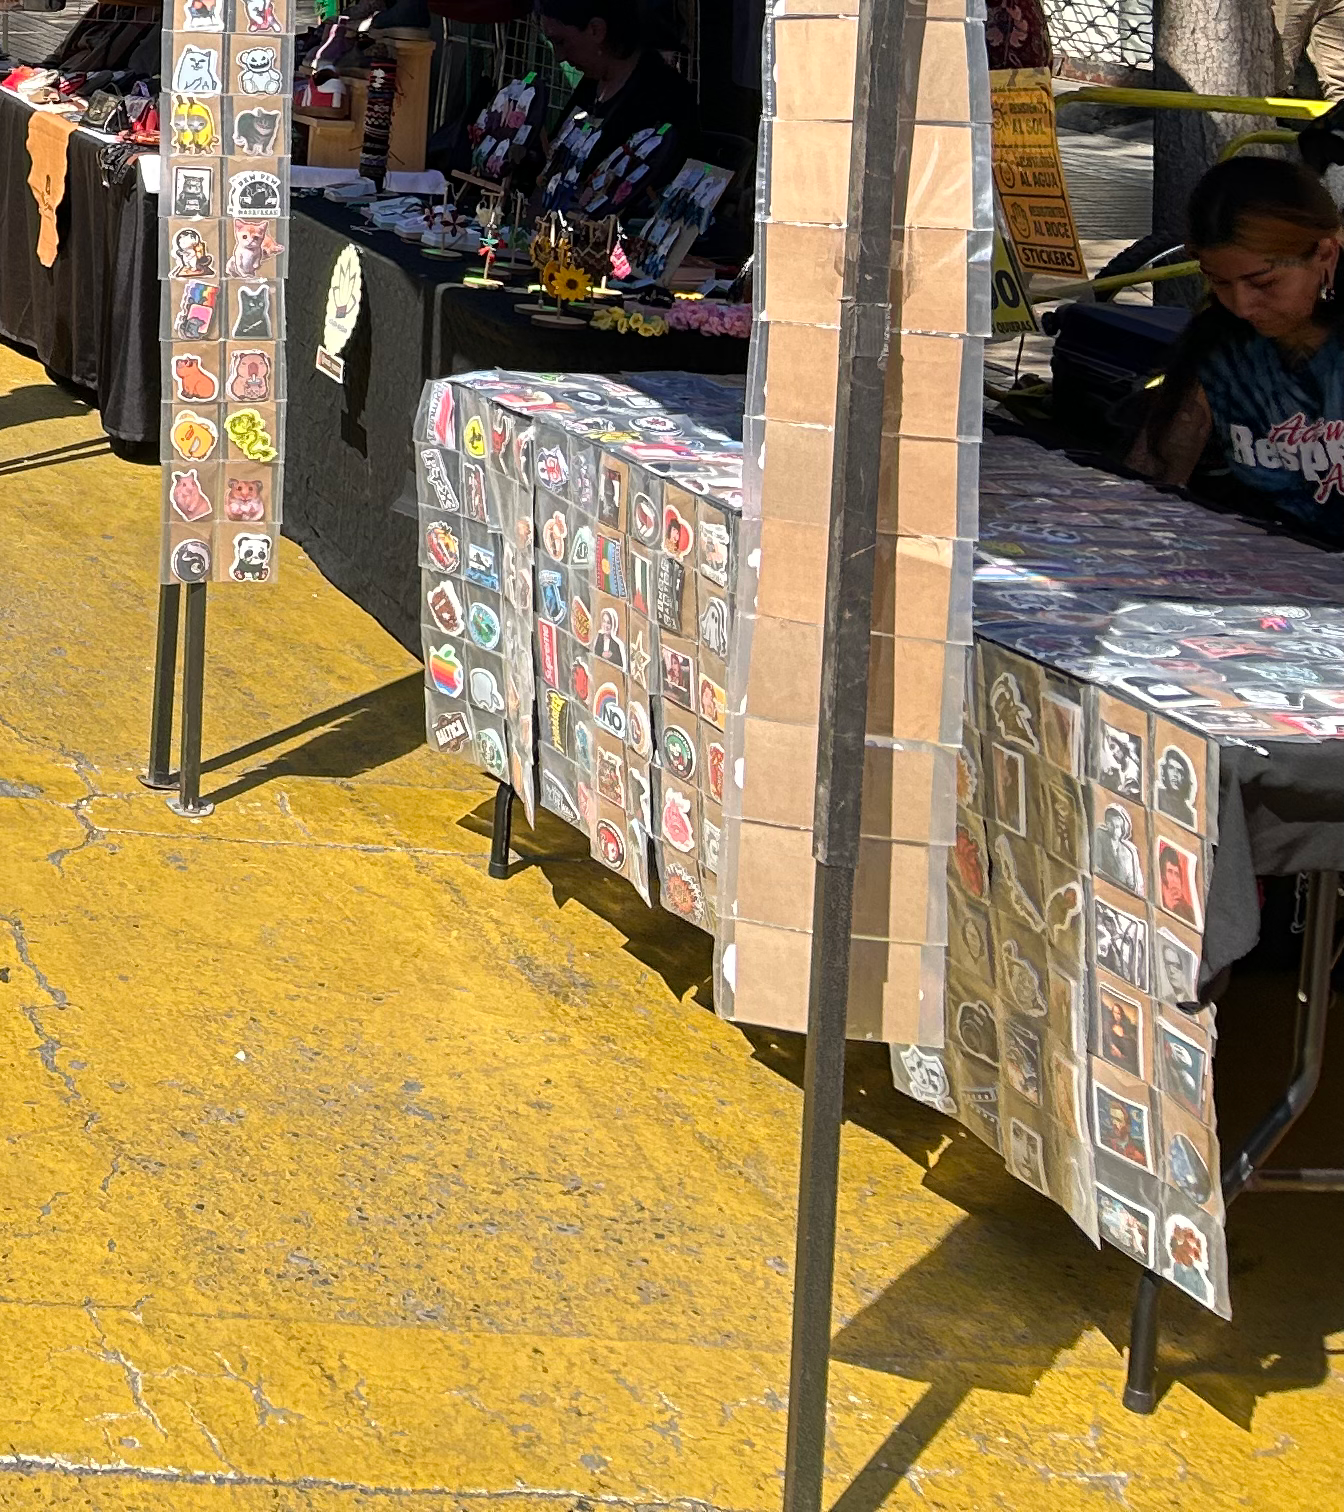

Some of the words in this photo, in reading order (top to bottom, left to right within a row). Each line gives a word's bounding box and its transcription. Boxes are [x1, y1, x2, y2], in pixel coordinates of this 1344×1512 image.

[1012, 119, 1024, 136] AL
[1025, 119, 1046, 136] SOL
[1020, 173, 1032, 187] AL
[1032, 172, 1060, 189] AGUA
[1033, 222, 1045, 237] AL
[1045, 222, 1072, 239] ROCE
[1022, 247, 1076, 268] STICKERS
[996, 320, 1033, 334] QUIERAS
[1229, 423, 1344, 482] Respe
[602, 702, 624, 733] NO
